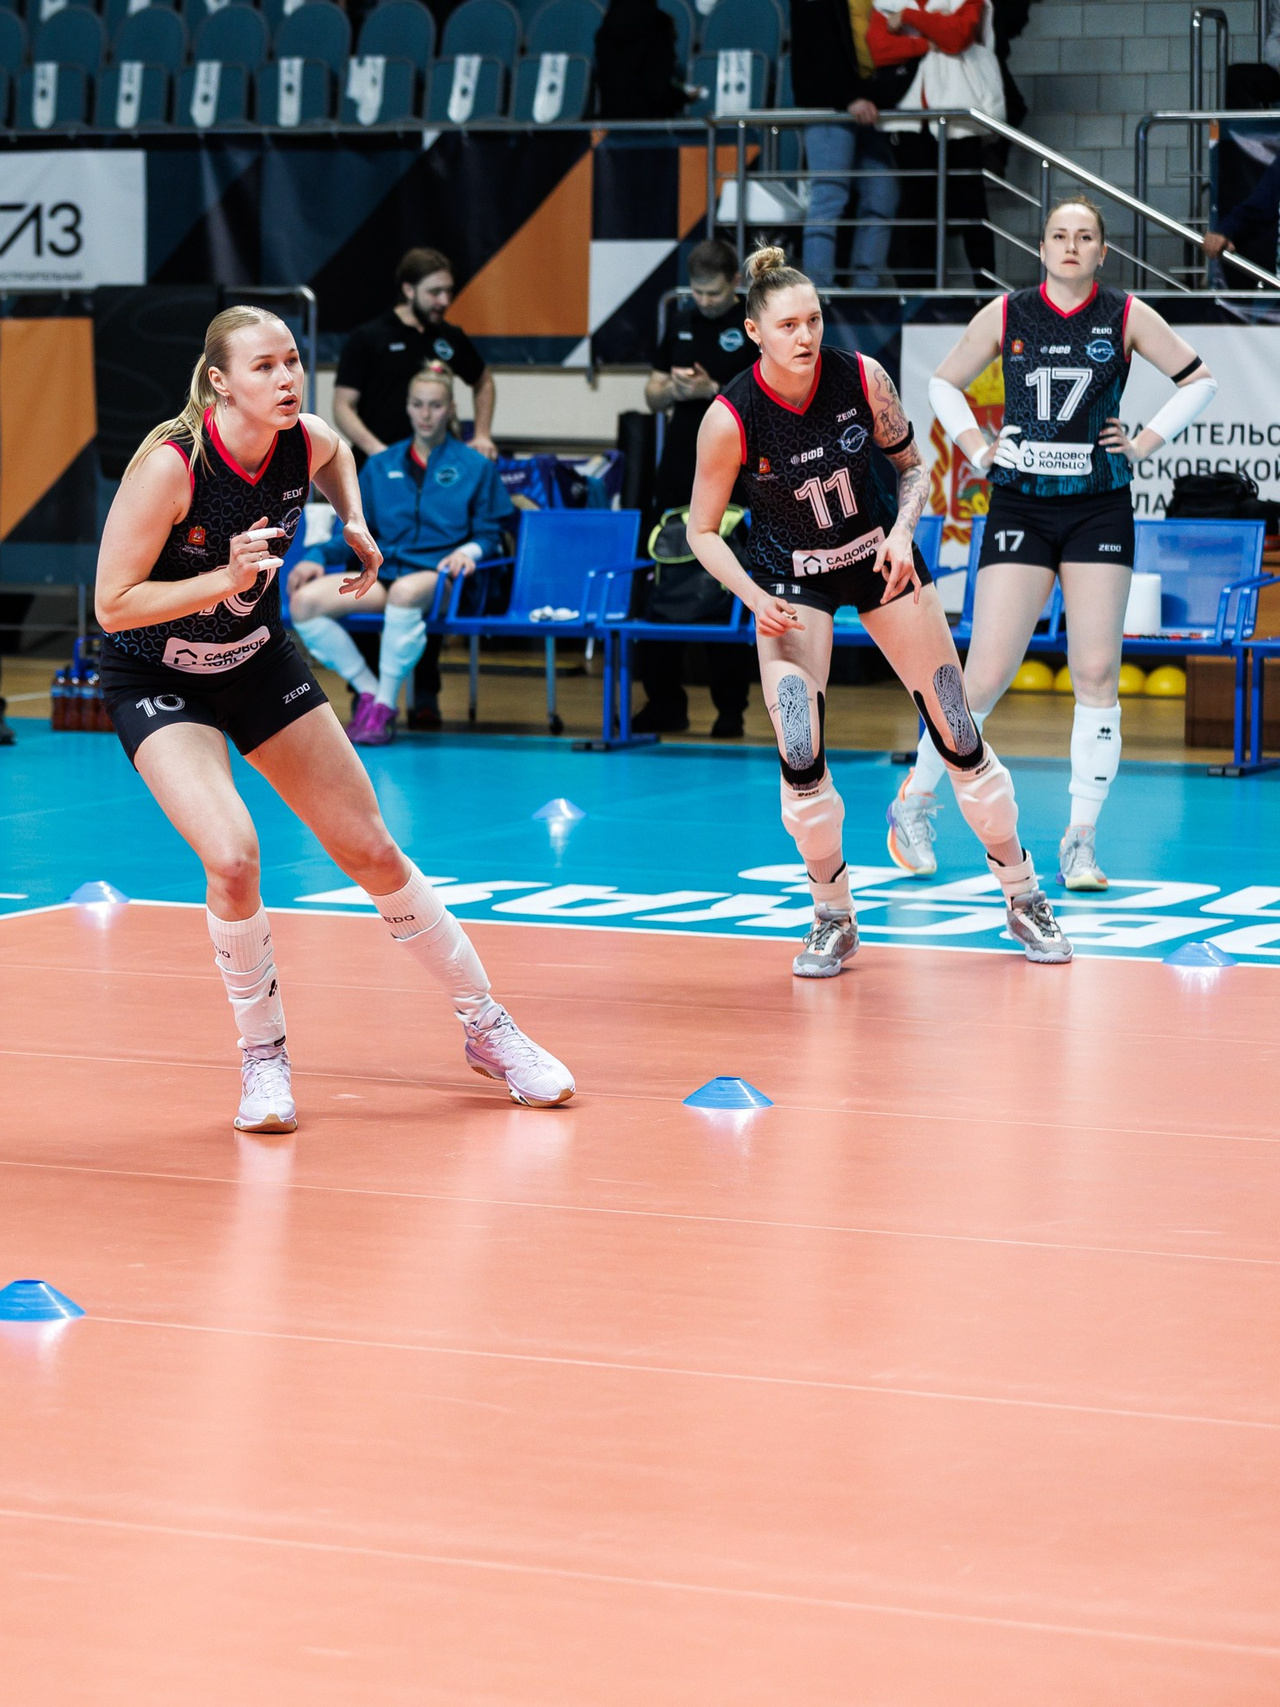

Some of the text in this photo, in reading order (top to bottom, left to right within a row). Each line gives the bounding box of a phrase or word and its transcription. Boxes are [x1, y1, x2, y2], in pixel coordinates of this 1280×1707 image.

[1026, 367, 1093, 421] 17
[836, 407, 858, 423] ZEDO
[801, 447, 824, 463] ВФВ
[1038, 460, 1085, 470] КОЛЬЦО
[1131, 455, 1280, 482] СКОВСКО
[794, 467, 858, 529] 11
[826, 535, 880, 565] САДОВОЕ
[994, 530, 1024, 552] 17
[282, 682, 311, 704] ZEDO
[136, 694, 186, 717] 10
